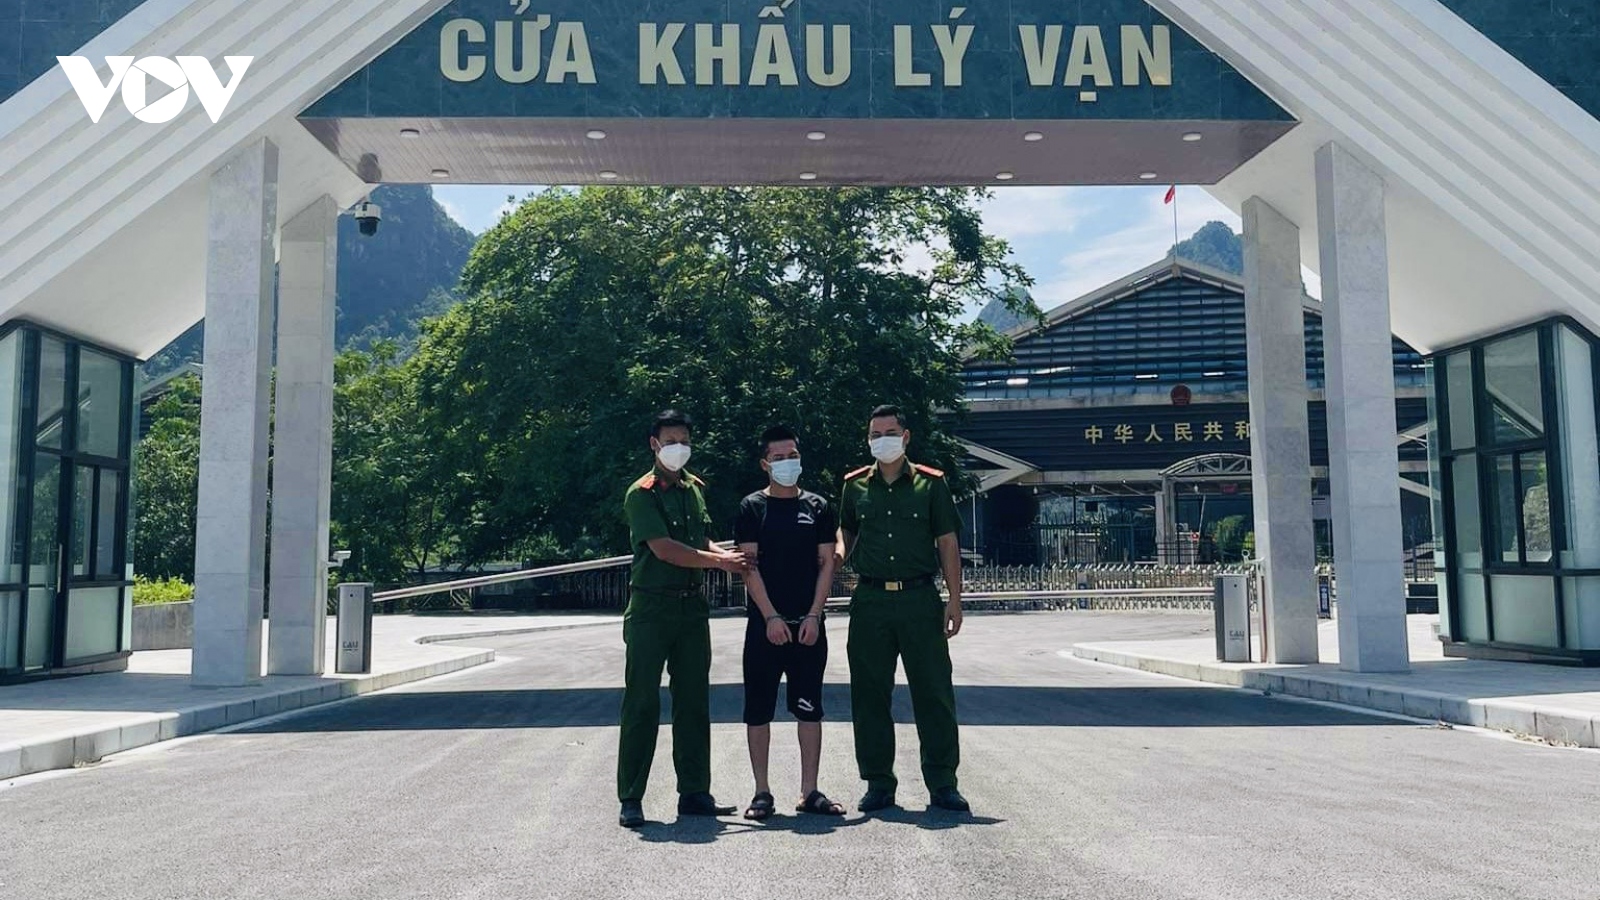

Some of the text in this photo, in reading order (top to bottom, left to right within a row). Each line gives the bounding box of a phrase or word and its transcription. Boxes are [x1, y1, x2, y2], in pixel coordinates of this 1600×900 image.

[440, 0, 1173, 102] CỬA KHẤU LÝ VẠN
